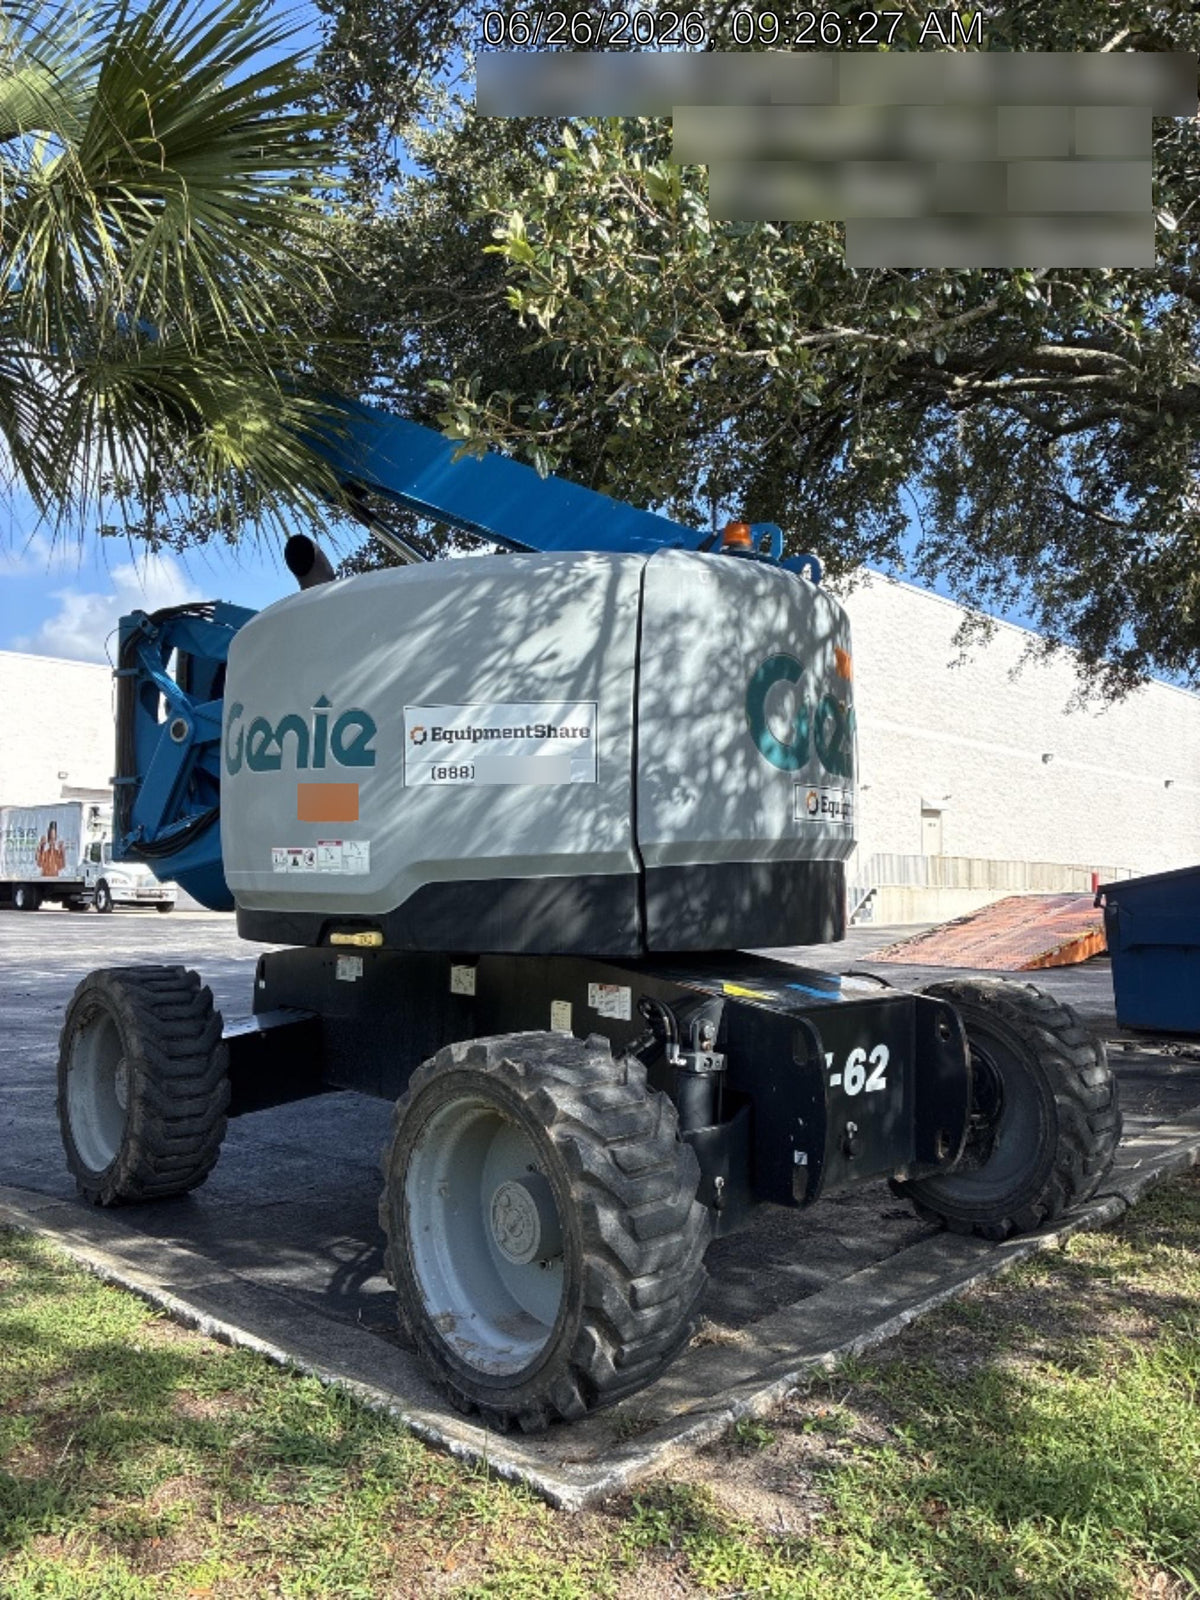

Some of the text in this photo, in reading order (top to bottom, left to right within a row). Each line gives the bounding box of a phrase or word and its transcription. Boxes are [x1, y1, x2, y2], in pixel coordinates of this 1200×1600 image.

[225, 692, 377, 776] Genie
[430, 724, 591, 744] EquipmentShare
[431, 765, 475, 781] (888)
